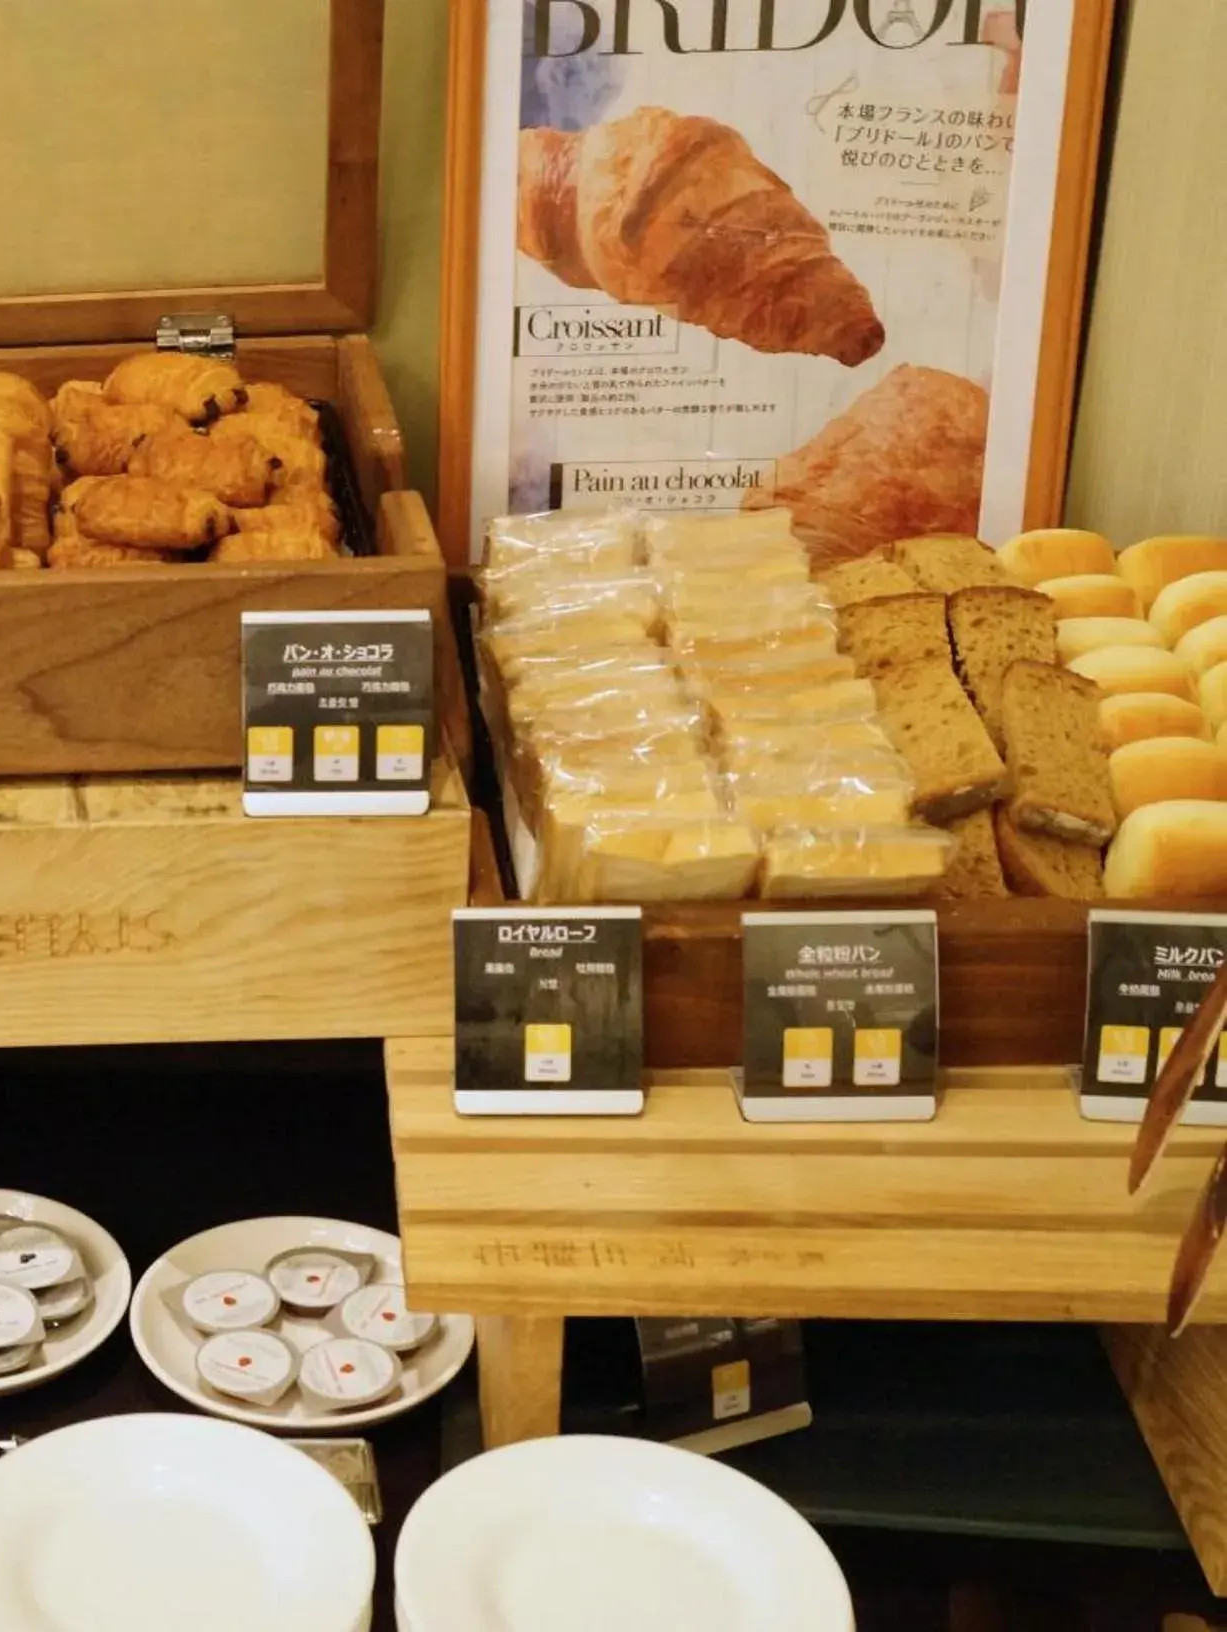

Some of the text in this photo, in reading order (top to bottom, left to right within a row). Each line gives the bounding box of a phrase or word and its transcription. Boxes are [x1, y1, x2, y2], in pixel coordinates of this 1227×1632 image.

[527, 309, 664, 341] Croissant
[573, 465, 762, 493] Pain au chocolat
[282, 644, 395, 662] パン・オ・ショコラ
[498, 924, 597, 941] ロイヤルローフ
[798, 945, 882, 964] 全粒粉パン
[1188, 970, 1216, 982] brea
